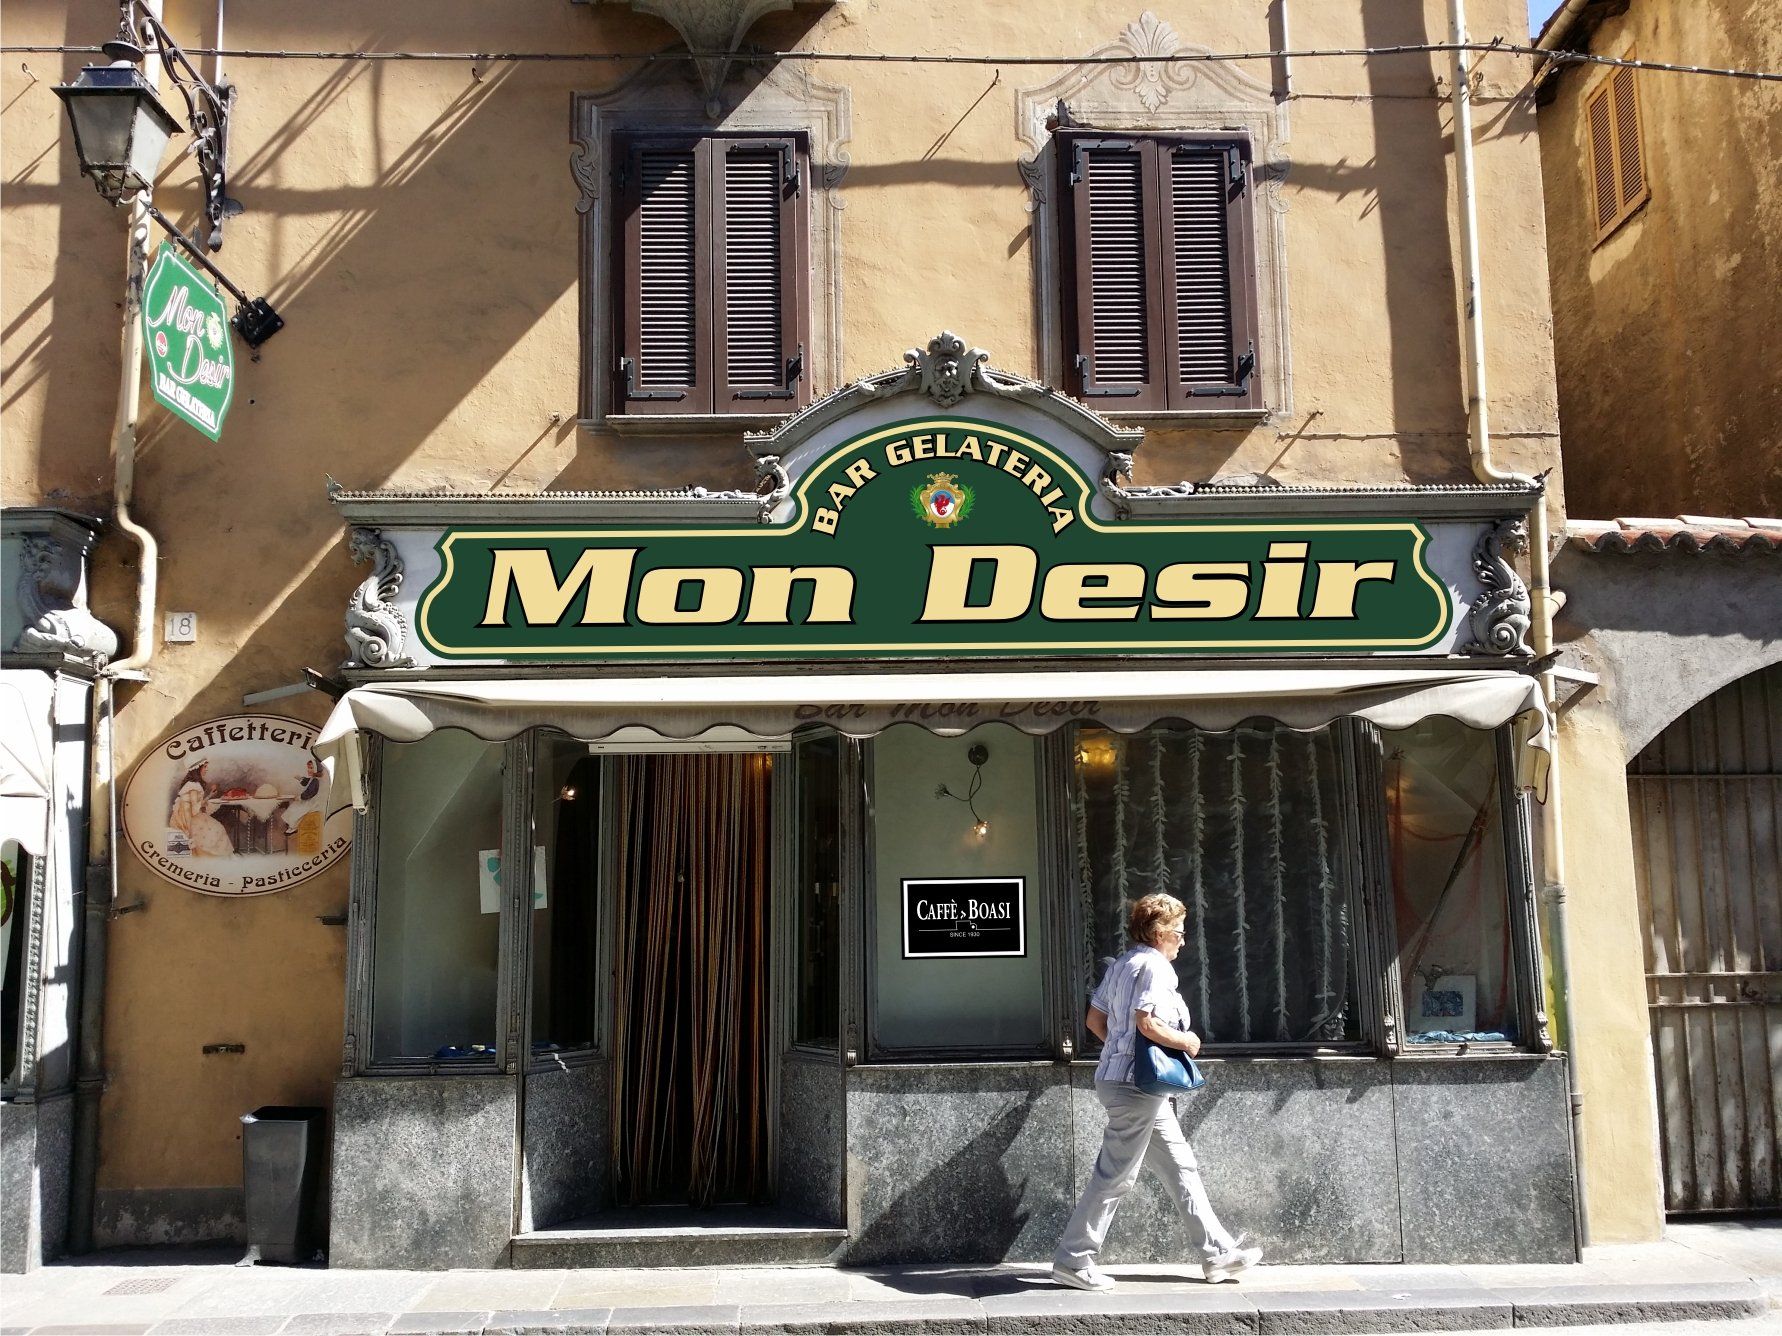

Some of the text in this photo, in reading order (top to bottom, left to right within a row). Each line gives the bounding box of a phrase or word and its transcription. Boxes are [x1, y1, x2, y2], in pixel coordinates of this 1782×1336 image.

[146, 286, 231, 389] Mon Desir
[811, 433, 1076, 538] BAR GELATERIA
[474, 541, 1398, 628] Mon Desir
[166, 719, 317, 760] Caffetteri
[140, 840, 221, 888] Cremeria
[241, 836, 347, 892] Pasticceria
[916, 899, 1011, 920] CAFFÈ BOASI
